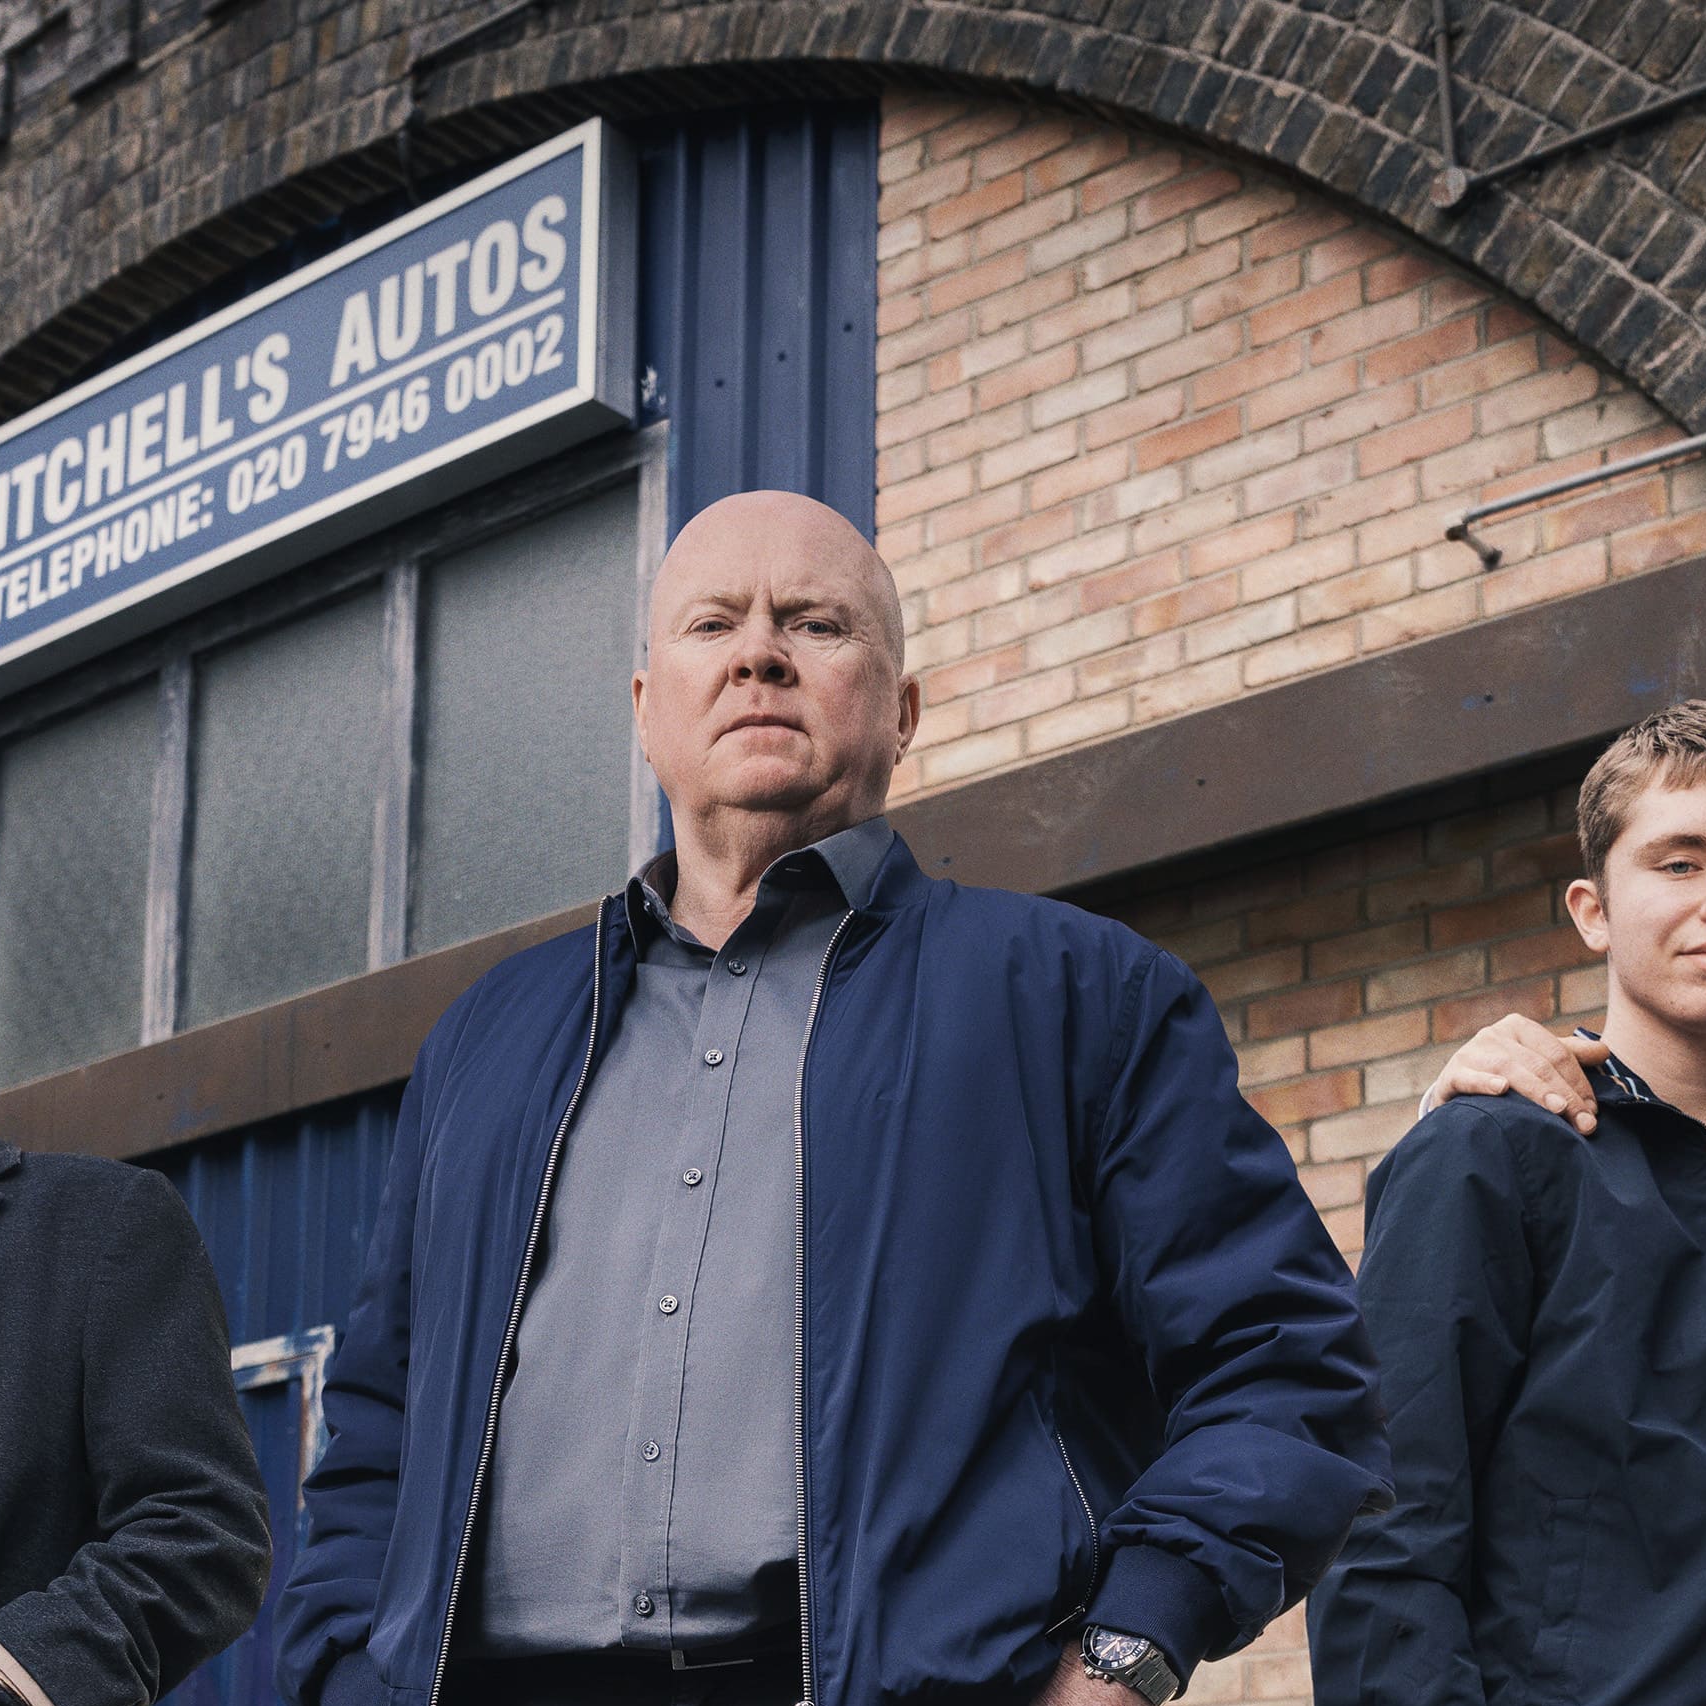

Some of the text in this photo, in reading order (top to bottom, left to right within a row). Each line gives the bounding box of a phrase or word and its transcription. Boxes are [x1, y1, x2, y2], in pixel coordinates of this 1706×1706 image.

[328, 195, 568, 389] AUTOS
[226, 433, 308, 515] 020
[319, 375, 431, 473] 7946
[443, 313, 565, 415] 0002
